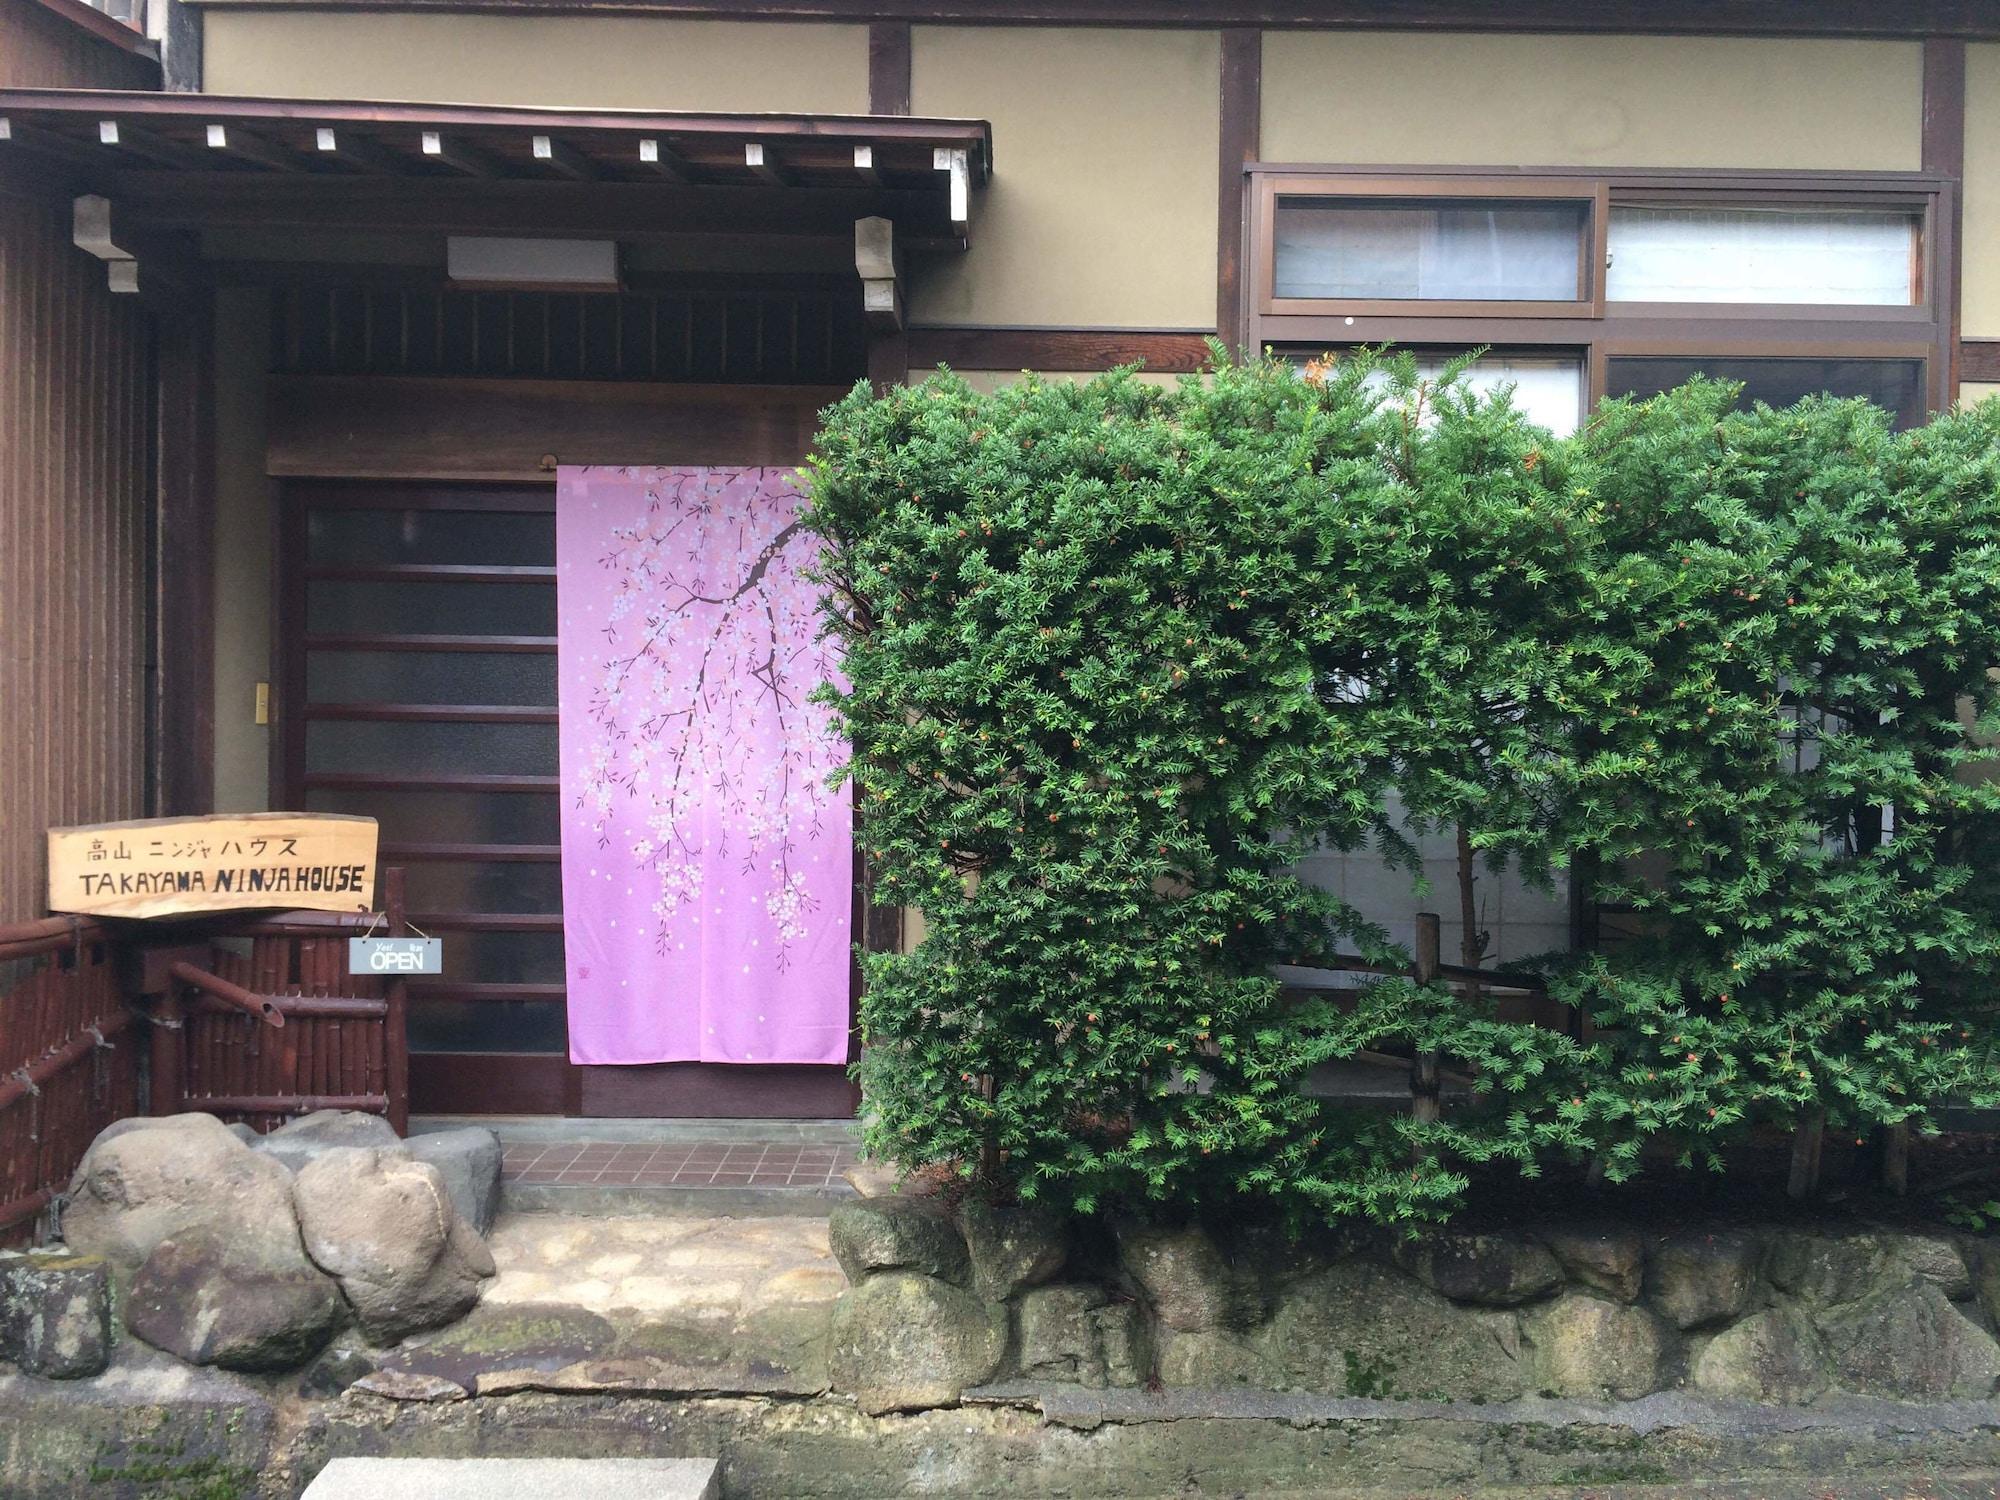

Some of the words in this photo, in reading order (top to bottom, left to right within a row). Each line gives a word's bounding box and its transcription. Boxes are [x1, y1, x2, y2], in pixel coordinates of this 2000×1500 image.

[87, 838, 132, 861] 高山
[79, 869, 206, 895] TAKAYAMA
[370, 952, 423, 970] OPEN
